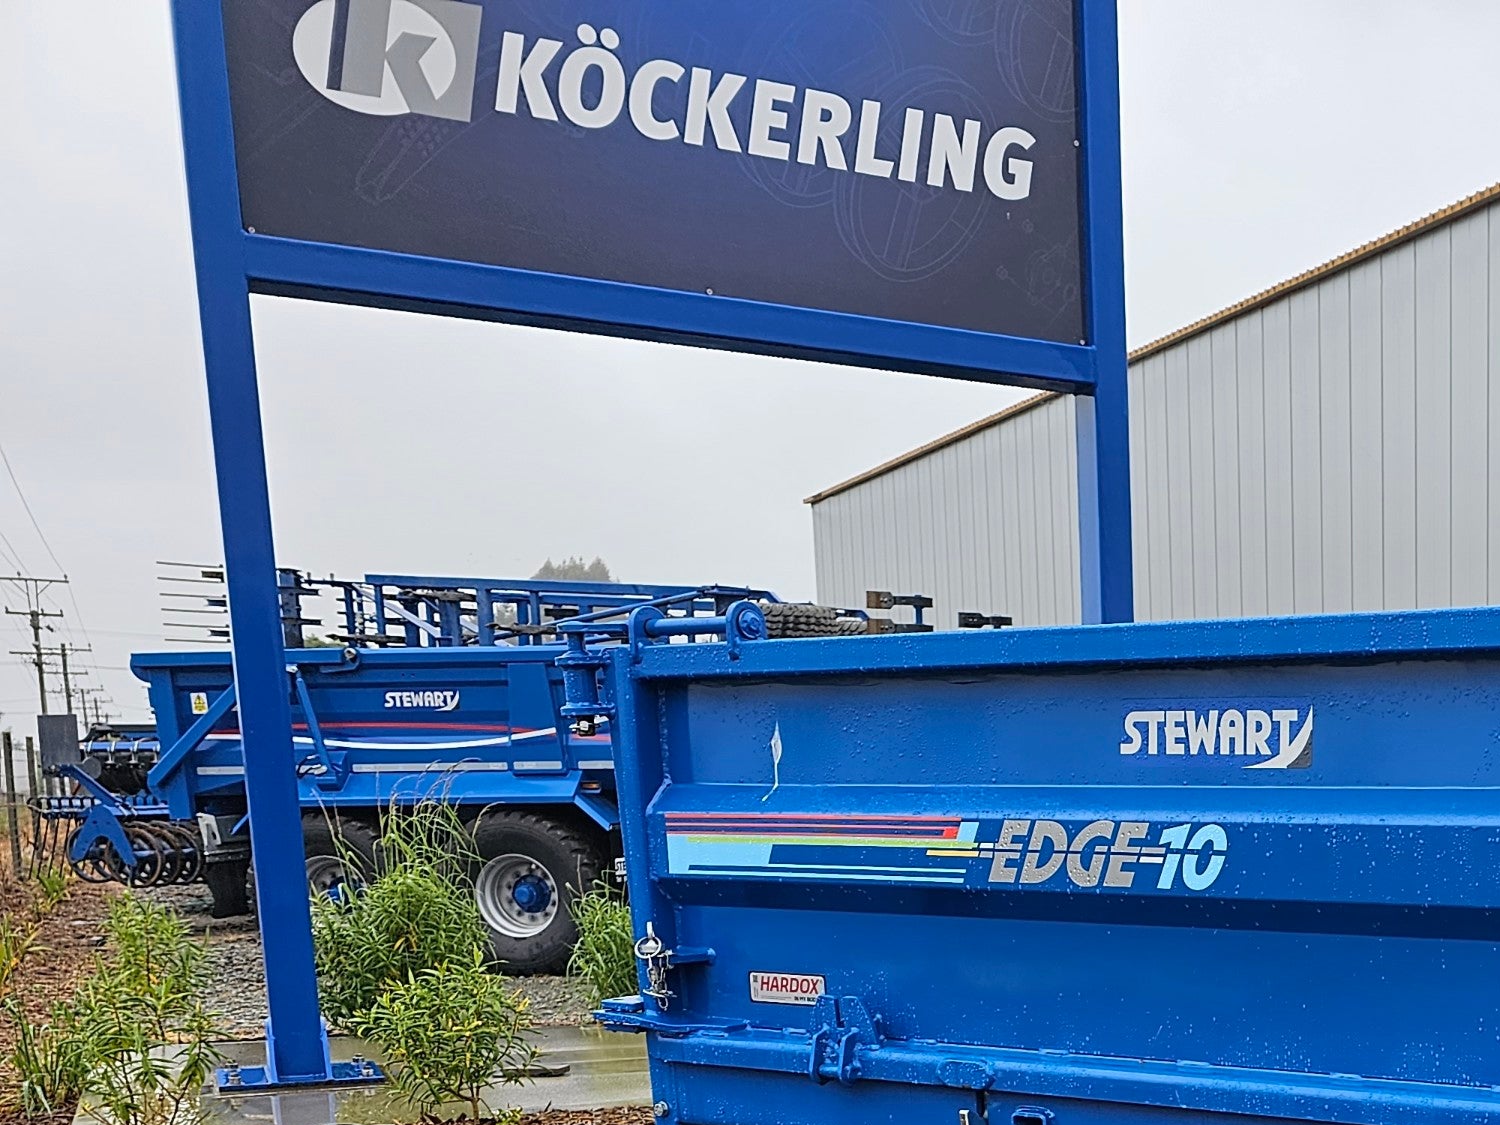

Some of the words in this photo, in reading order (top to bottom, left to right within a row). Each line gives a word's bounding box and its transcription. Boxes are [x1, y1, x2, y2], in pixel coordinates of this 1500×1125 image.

[495, 23, 1036, 200] KÖCKERLING
[384, 690, 459, 711] STEWART
[1120, 704, 1313, 769] STEWART
[760, 976, 819, 994] HARDOX
